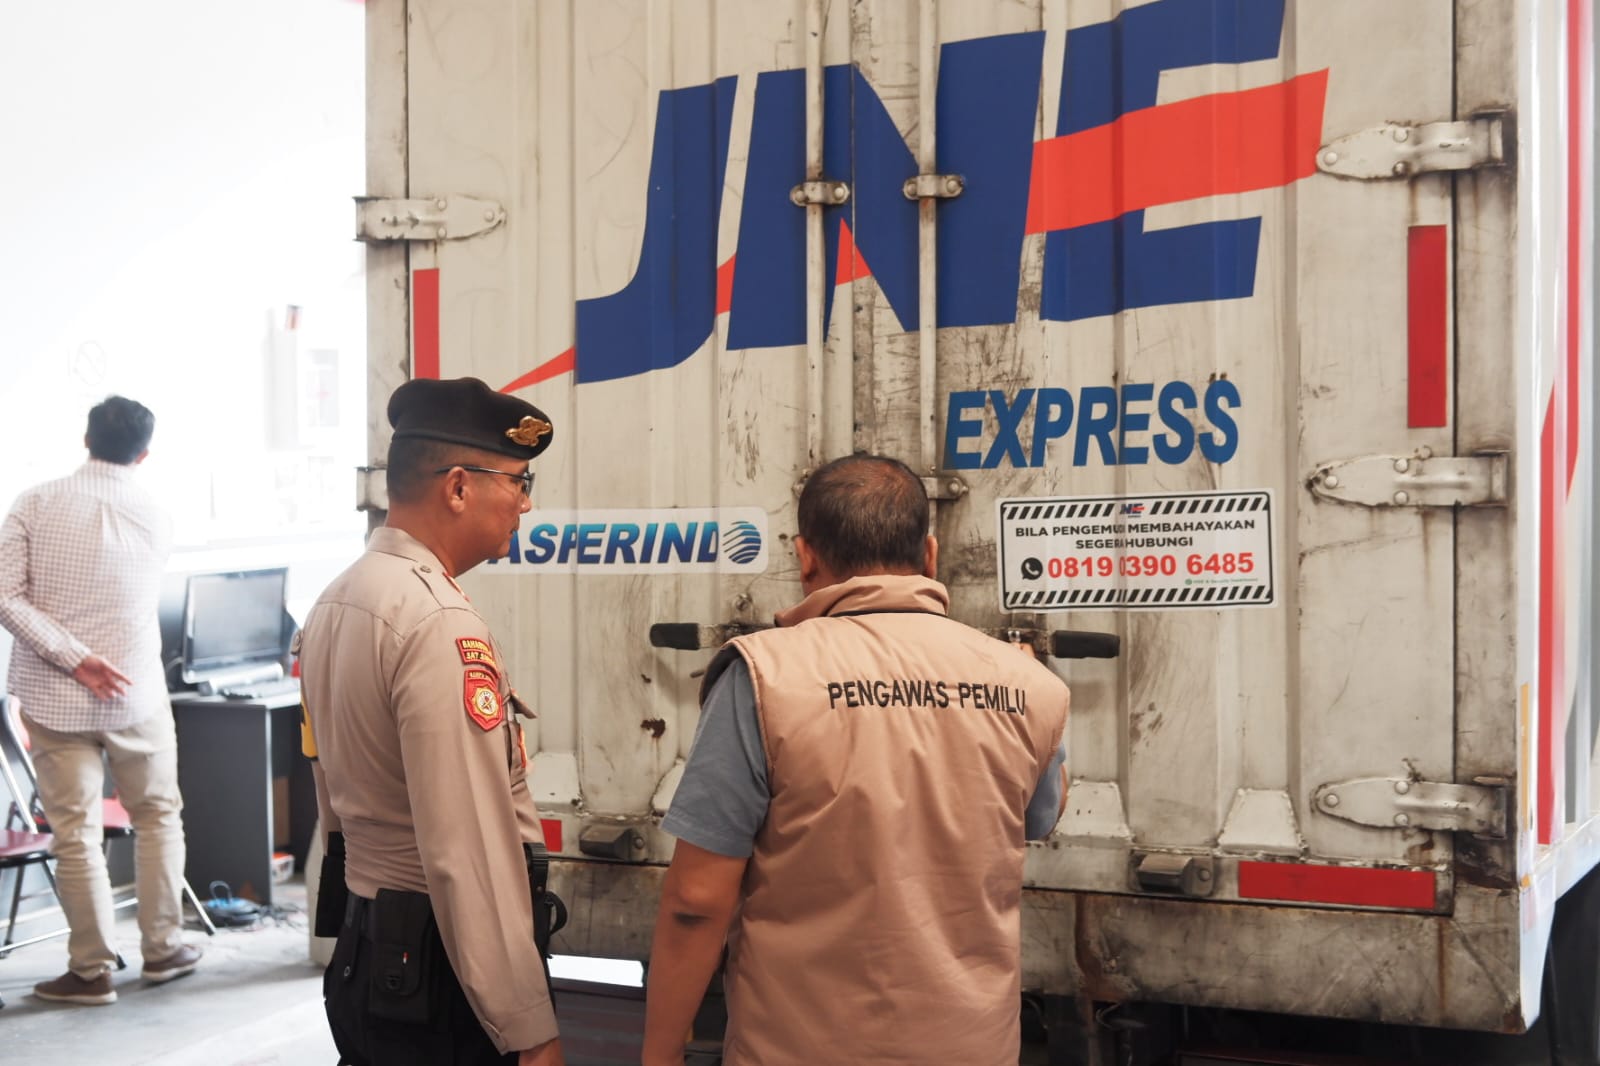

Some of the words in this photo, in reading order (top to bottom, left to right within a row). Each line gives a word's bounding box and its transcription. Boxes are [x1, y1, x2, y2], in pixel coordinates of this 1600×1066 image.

[576, 0, 1329, 385] JNE
[943, 379, 1242, 470] EXPRESS
[1015, 526, 1049, 538] BILA
[1127, 520, 1256, 534] MEMBAHAYAKAN
[1075, 538, 1125, 550] SEGERA
[1125, 536, 1194, 549] HUBUNGI
[1047, 555, 1113, 579] 0819
[1119, 554, 1177, 577] 0390
[1186, 552, 1255, 576] 6485
[827, 679, 950, 709] PENGAWAS
[957, 682, 1026, 716] PEMILU
